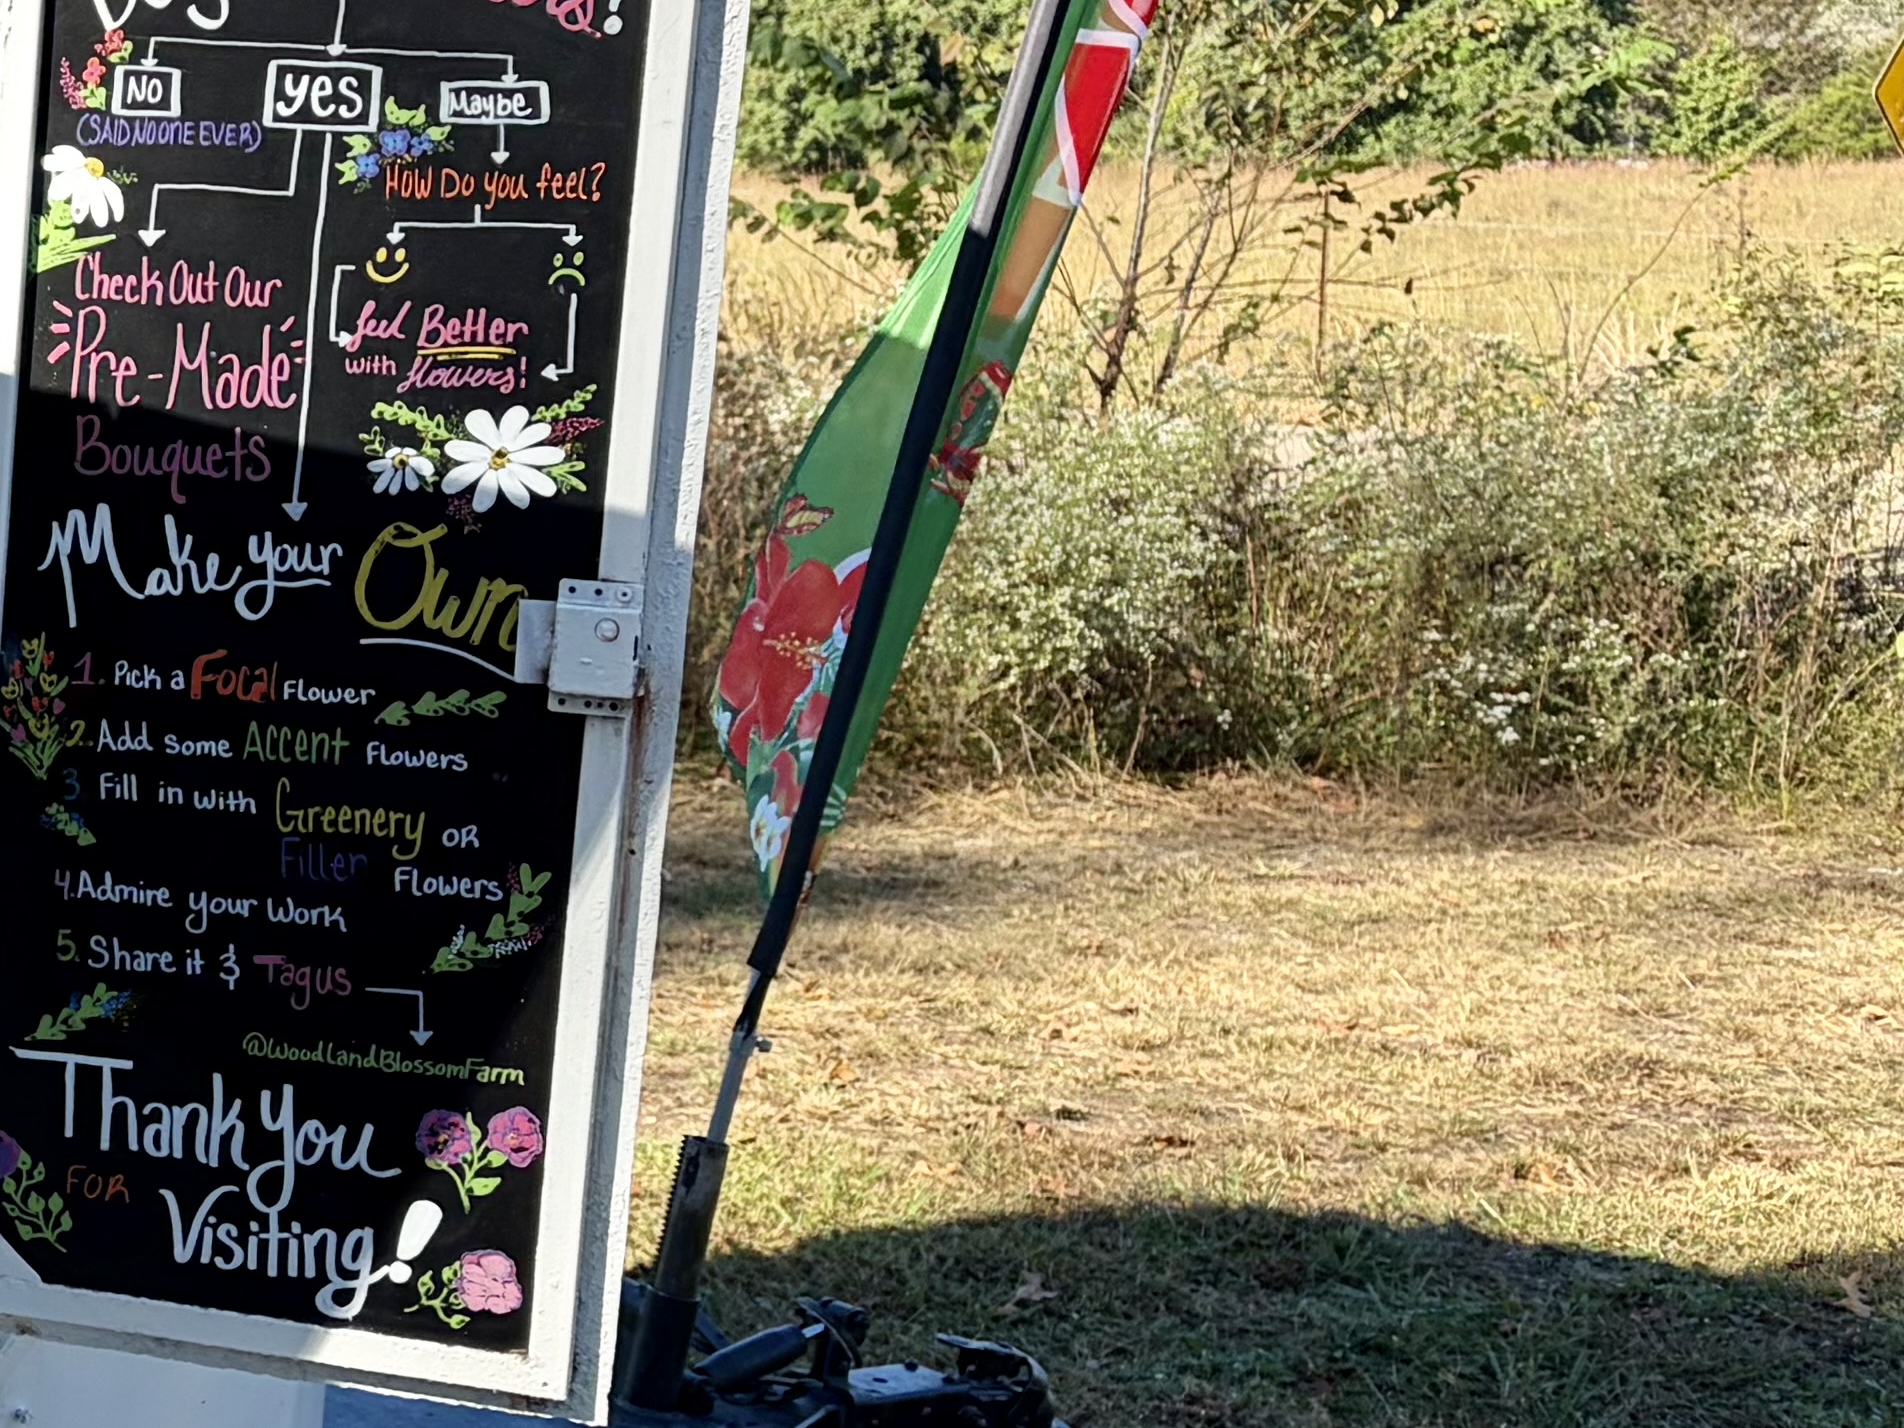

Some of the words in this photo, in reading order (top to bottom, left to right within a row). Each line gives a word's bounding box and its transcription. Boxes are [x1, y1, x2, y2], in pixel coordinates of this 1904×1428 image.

[449, 90, 533, 121] Maybe
[484, 171, 529, 210] you
[536, 161, 607, 203] feel?
[74, 251, 164, 306] Check
[168, 259, 220, 305] Out
[224, 265, 283, 308] Our
[416, 303, 530, 348] Better
[345, 353, 397, 377] with
[73, 414, 272, 505] Bouquets
[38, 503, 243, 628] Make
[233, 531, 344, 621] your
[354, 522, 530, 652] Own
[170, 668, 187, 692] a
[191, 649, 279, 703] Focal
[96, 718, 154, 754] Add
[164, 734, 234, 759] some
[242, 720, 351, 765] Accent
[99, 772, 139, 803] Fill
[158, 780, 185, 806] in
[275, 777, 426, 861] Greenery
[280, 835, 369, 883] Filler
[76, 870, 174, 909] Admire
[184, 890, 259, 935] your
[87, 935, 177, 973] Share
[185, 947, 206, 976] it
[9, 1046, 250, 1170] Thank
[65, 1165, 131, 1204] FOR
